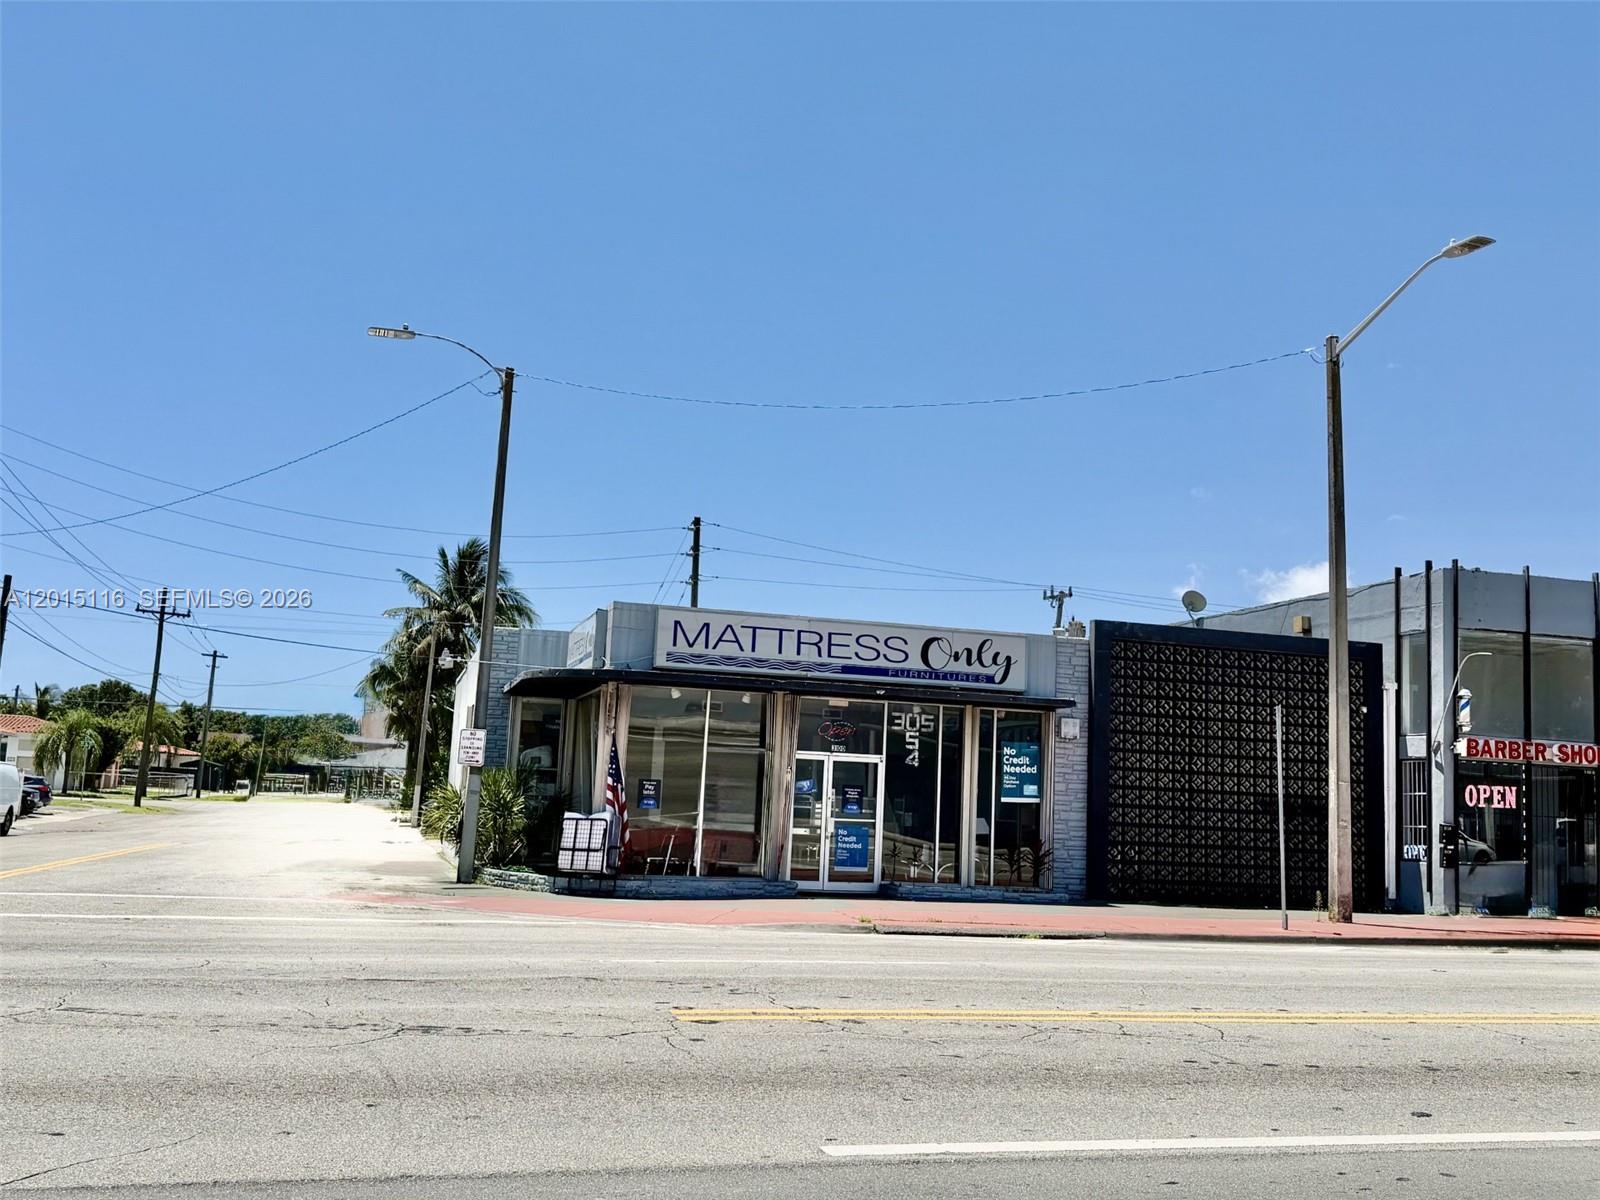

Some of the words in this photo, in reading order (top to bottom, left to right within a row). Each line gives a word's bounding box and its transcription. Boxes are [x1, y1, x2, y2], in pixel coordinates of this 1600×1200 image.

[672, 620, 909, 663] MATTRESS
[921, 636, 1018, 685] Only
[888, 669, 987, 683] FURNITURES
[891, 711, 935, 733] 305
[1003, 746, 1017, 755] No
[1466, 738, 1547, 761] BARBER
[1556, 744, 1600, 765] SHO
[1003, 755, 1030, 765] Credit
[1003, 764, 1038, 774] Needed
[1464, 784, 1517, 809] OPEN
[1403, 844, 1428, 861] OPE
